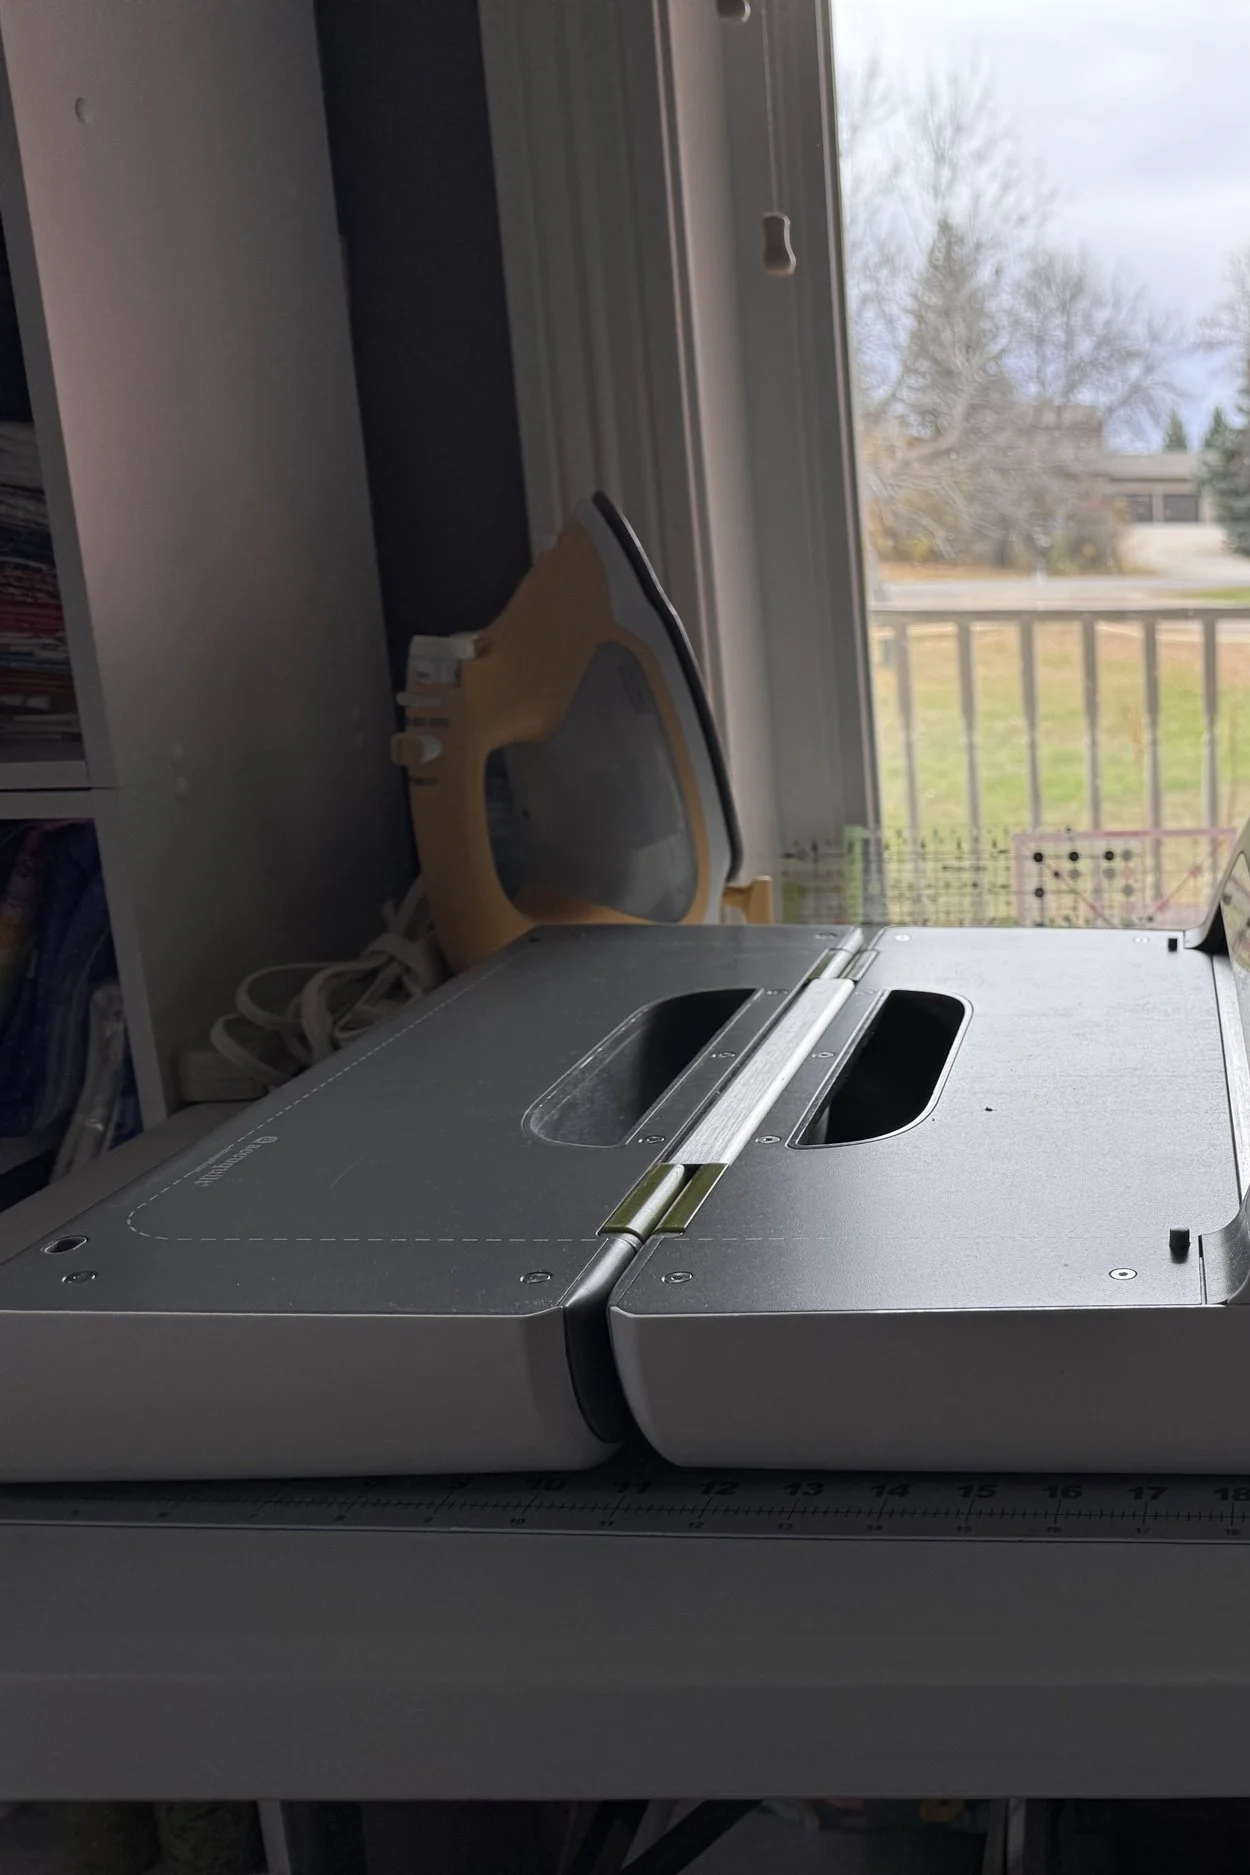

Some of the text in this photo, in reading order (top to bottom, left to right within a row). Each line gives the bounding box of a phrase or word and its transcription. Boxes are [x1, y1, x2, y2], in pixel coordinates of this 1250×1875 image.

[448, 1474, 474, 1489] 9
[526, 1477, 569, 1491] 10
[614, 1479, 653, 1494] 11
[698, 1480, 740, 1495] 12
[785, 1482, 824, 1496] 13
[870, 1483, 910, 1497] 14
[958, 1484, 998, 1498] 15
[1043, 1485, 1082, 1499] 16
[1128, 1486, 1168, 1500] 17
